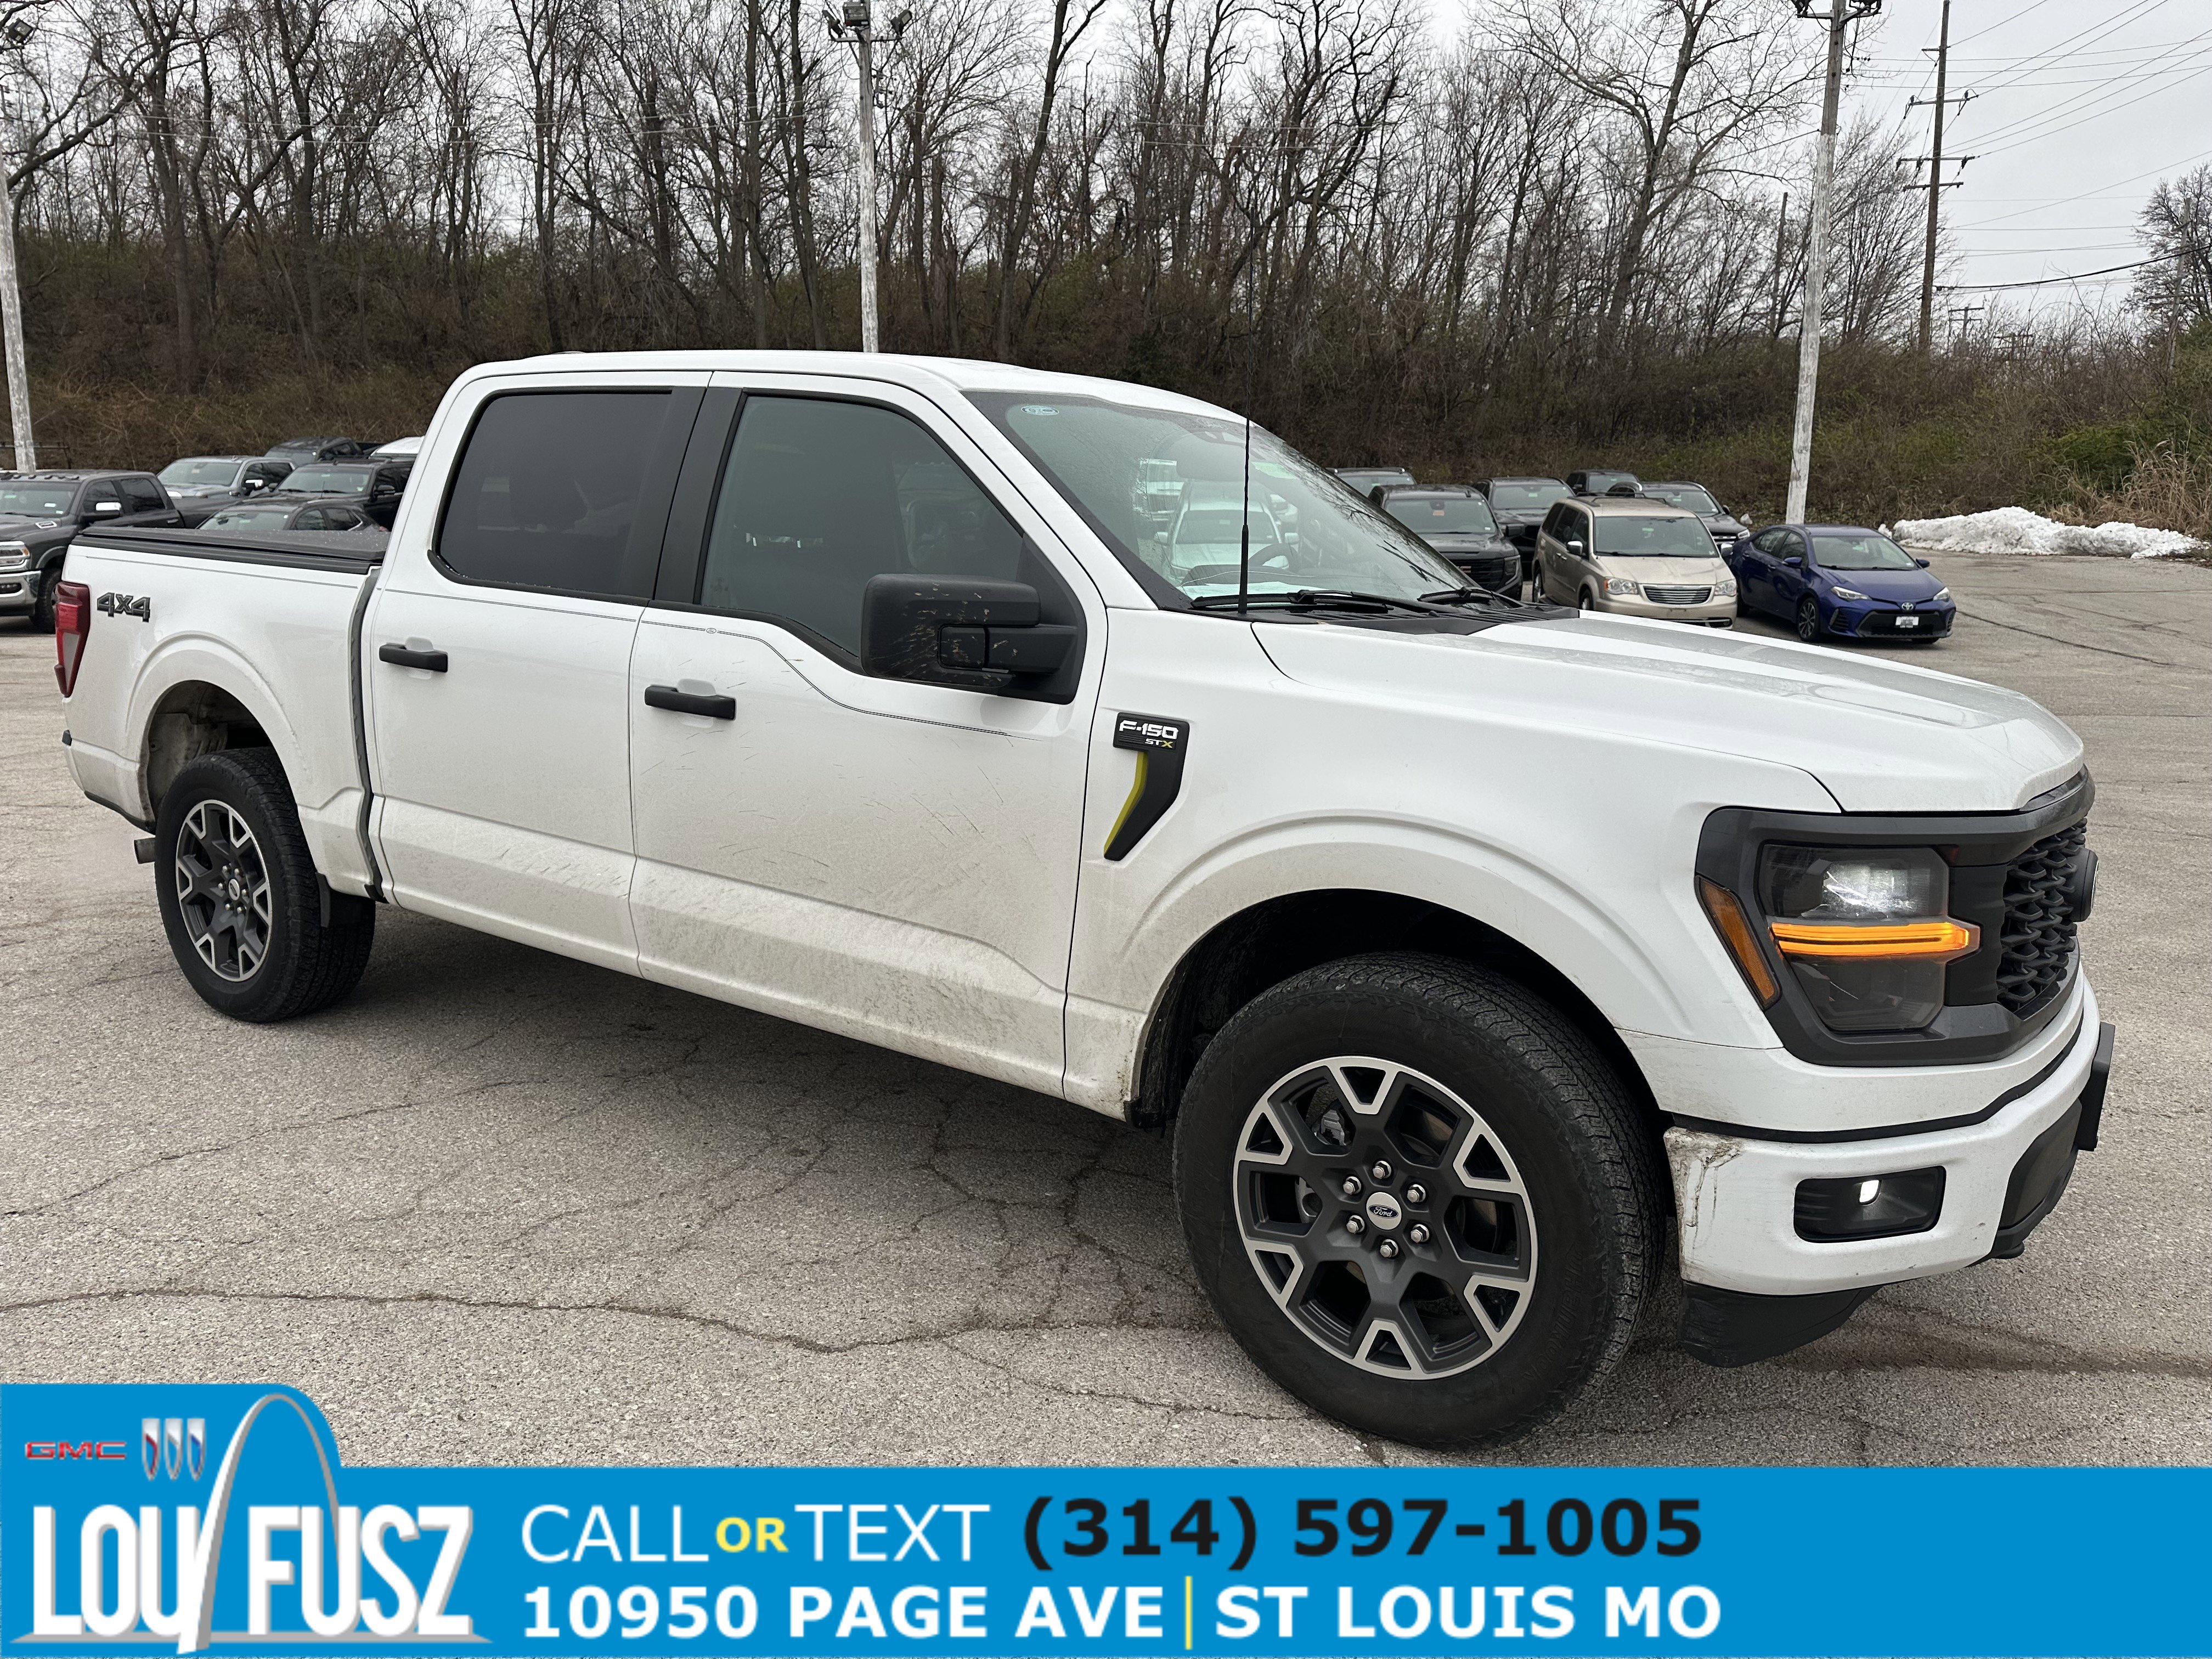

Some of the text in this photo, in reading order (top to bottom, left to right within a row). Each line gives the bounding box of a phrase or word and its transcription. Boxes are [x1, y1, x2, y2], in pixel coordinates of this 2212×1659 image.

[1119, 720, 1179, 740] F-150
[1144, 738, 1173, 748] STX
[1373, 1206, 1393, 1217] Ford
